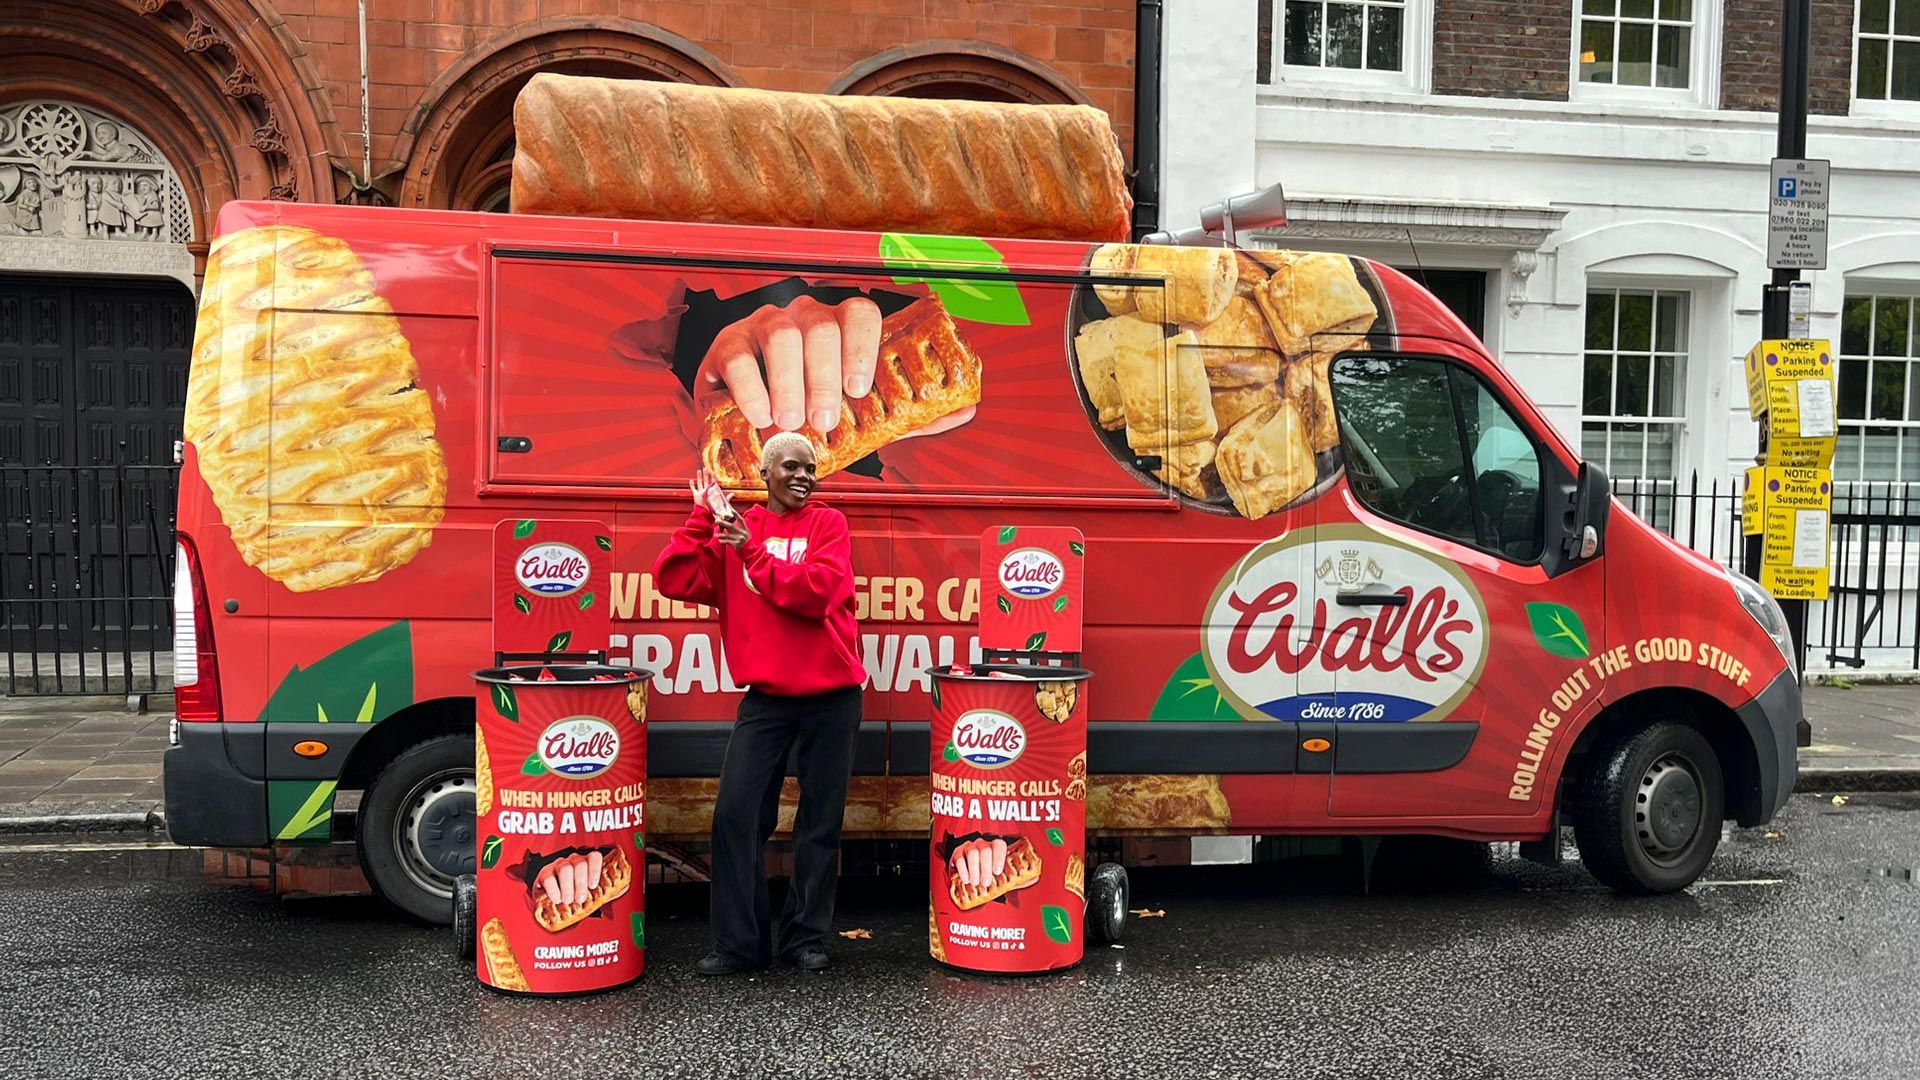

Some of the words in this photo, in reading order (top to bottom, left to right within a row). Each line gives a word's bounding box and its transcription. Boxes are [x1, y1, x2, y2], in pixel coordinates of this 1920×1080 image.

[1782, 180, 1794, 196] P
[1800, 180, 1811, 188] Pay
[1773, 198, 1787, 206] 020
[1796, 217, 1809, 225] 022
[1781, 342, 1815, 351] NOTICE
[1783, 357, 1816, 366] Parking
[1776, 368, 1824, 378] Suspended
[1794, 449, 1820, 457] waiting
[1784, 469, 1818, 479] NOTICE
[1785, 484, 1817, 494] Parking
[1776, 495, 1823, 505] Suspended
[521, 556, 586, 581] Wall's
[1004, 560, 1061, 584] Wall's
[1788, 577, 1815, 586] waiting
[1786, 588, 1815, 597] Loading
[1227, 581, 1474, 682] Wall's
[1301, 702, 1346, 719] Since
[1349, 703, 1385, 720] 1786
[1509, 708, 1560, 801] ROLLING
[1551, 668, 1591, 711] OUT
[1589, 645, 1632, 680] THE
[1635, 638, 1692, 663] GOOD
[1697, 643, 1751, 687] STUFF
[957, 723, 1022, 752] Wall's
[545, 731, 617, 759] Wall's
[932, 772, 957, 792] WHEN
[958, 778, 1016, 797] HUNGER
[1020, 780, 1062, 797] CALLS,
[500, 789, 543, 808] WHEN
[547, 789, 611, 808] HUNGER
[932, 792, 964, 818] GRAB
[968, 799, 982, 820] A
[987, 800, 1060, 821] WALL'S!
[498, 811, 555, 834] GRAB
[560, 811, 577, 834] A
[582, 803, 643, 833] WALL'S!
[949, 922, 989, 939] CRAVING
[991, 928, 1025, 940] MORE?
[534, 945, 584, 959] CRAVING
[586, 940, 619, 957] MORE?
[949, 937, 978, 947] FOLLOW
[979, 941, 990, 949] US
[534, 961, 571, 969] FOLLOW
[574, 960, 586, 968] US
